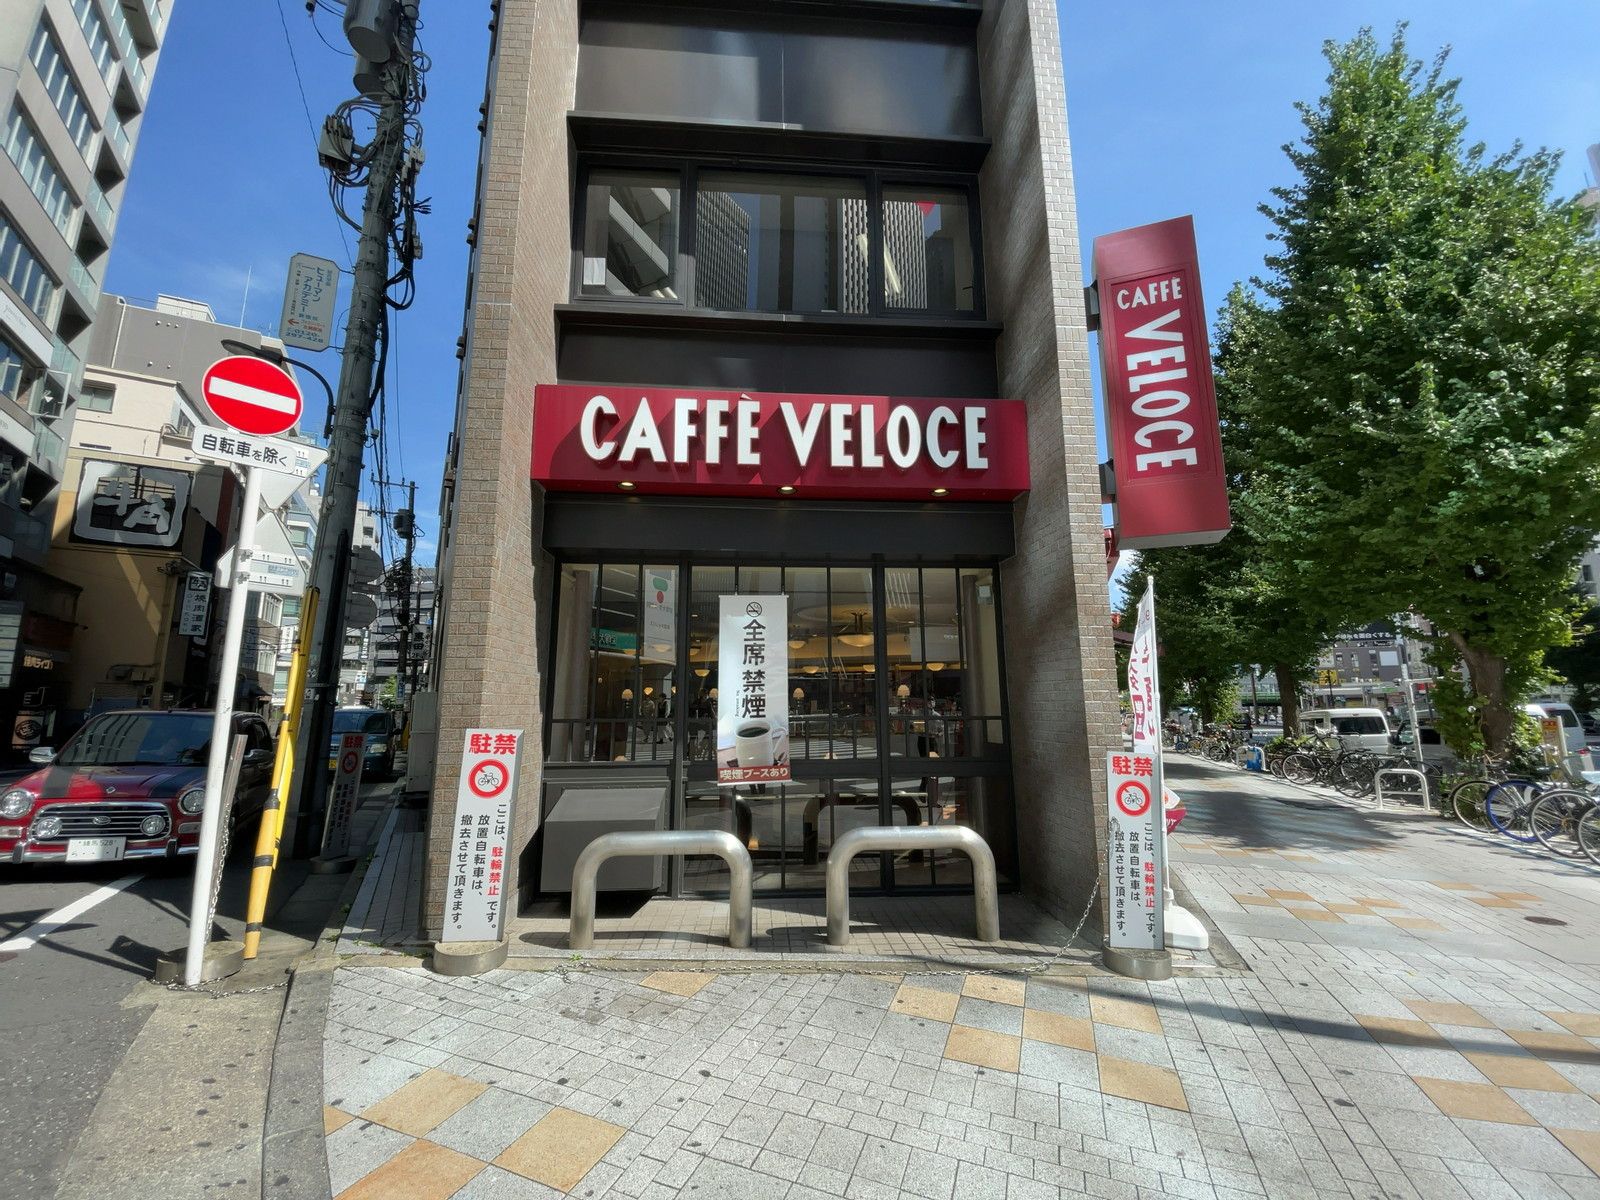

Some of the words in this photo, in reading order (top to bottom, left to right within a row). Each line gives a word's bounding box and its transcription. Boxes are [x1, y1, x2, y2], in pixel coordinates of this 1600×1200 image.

[300, 275, 313, 313] アカデミー
[312, 267, 325, 302] ヒューマン
[1117, 276, 1182, 310] CAFFÈ
[1124, 308, 1198, 472] VELOCE
[201, 433, 288, 467] 自転車を除く
[580, 393, 762, 466] CAFFÈ
[779, 402, 989, 470] VELOCE
[741, 619, 767, 719] 全席禁煙
[469, 733, 517, 755] 駐禁
[719, 766, 789, 780] 喫煙ブースあり
[1112, 755, 1153, 777] 駐禁
[451, 814, 473, 930] 撤去させて頂きます。
[471, 814, 490, 897] 放置自転車は、
[485, 804, 508, 929] ここは、駐輪禁止です。
[1114, 831, 1127, 937] 撤去させて頂きます。
[1129, 831, 1142, 908] 放置自転車は、
[1144, 822, 1157, 939] ここは、駐輪禁止です。
